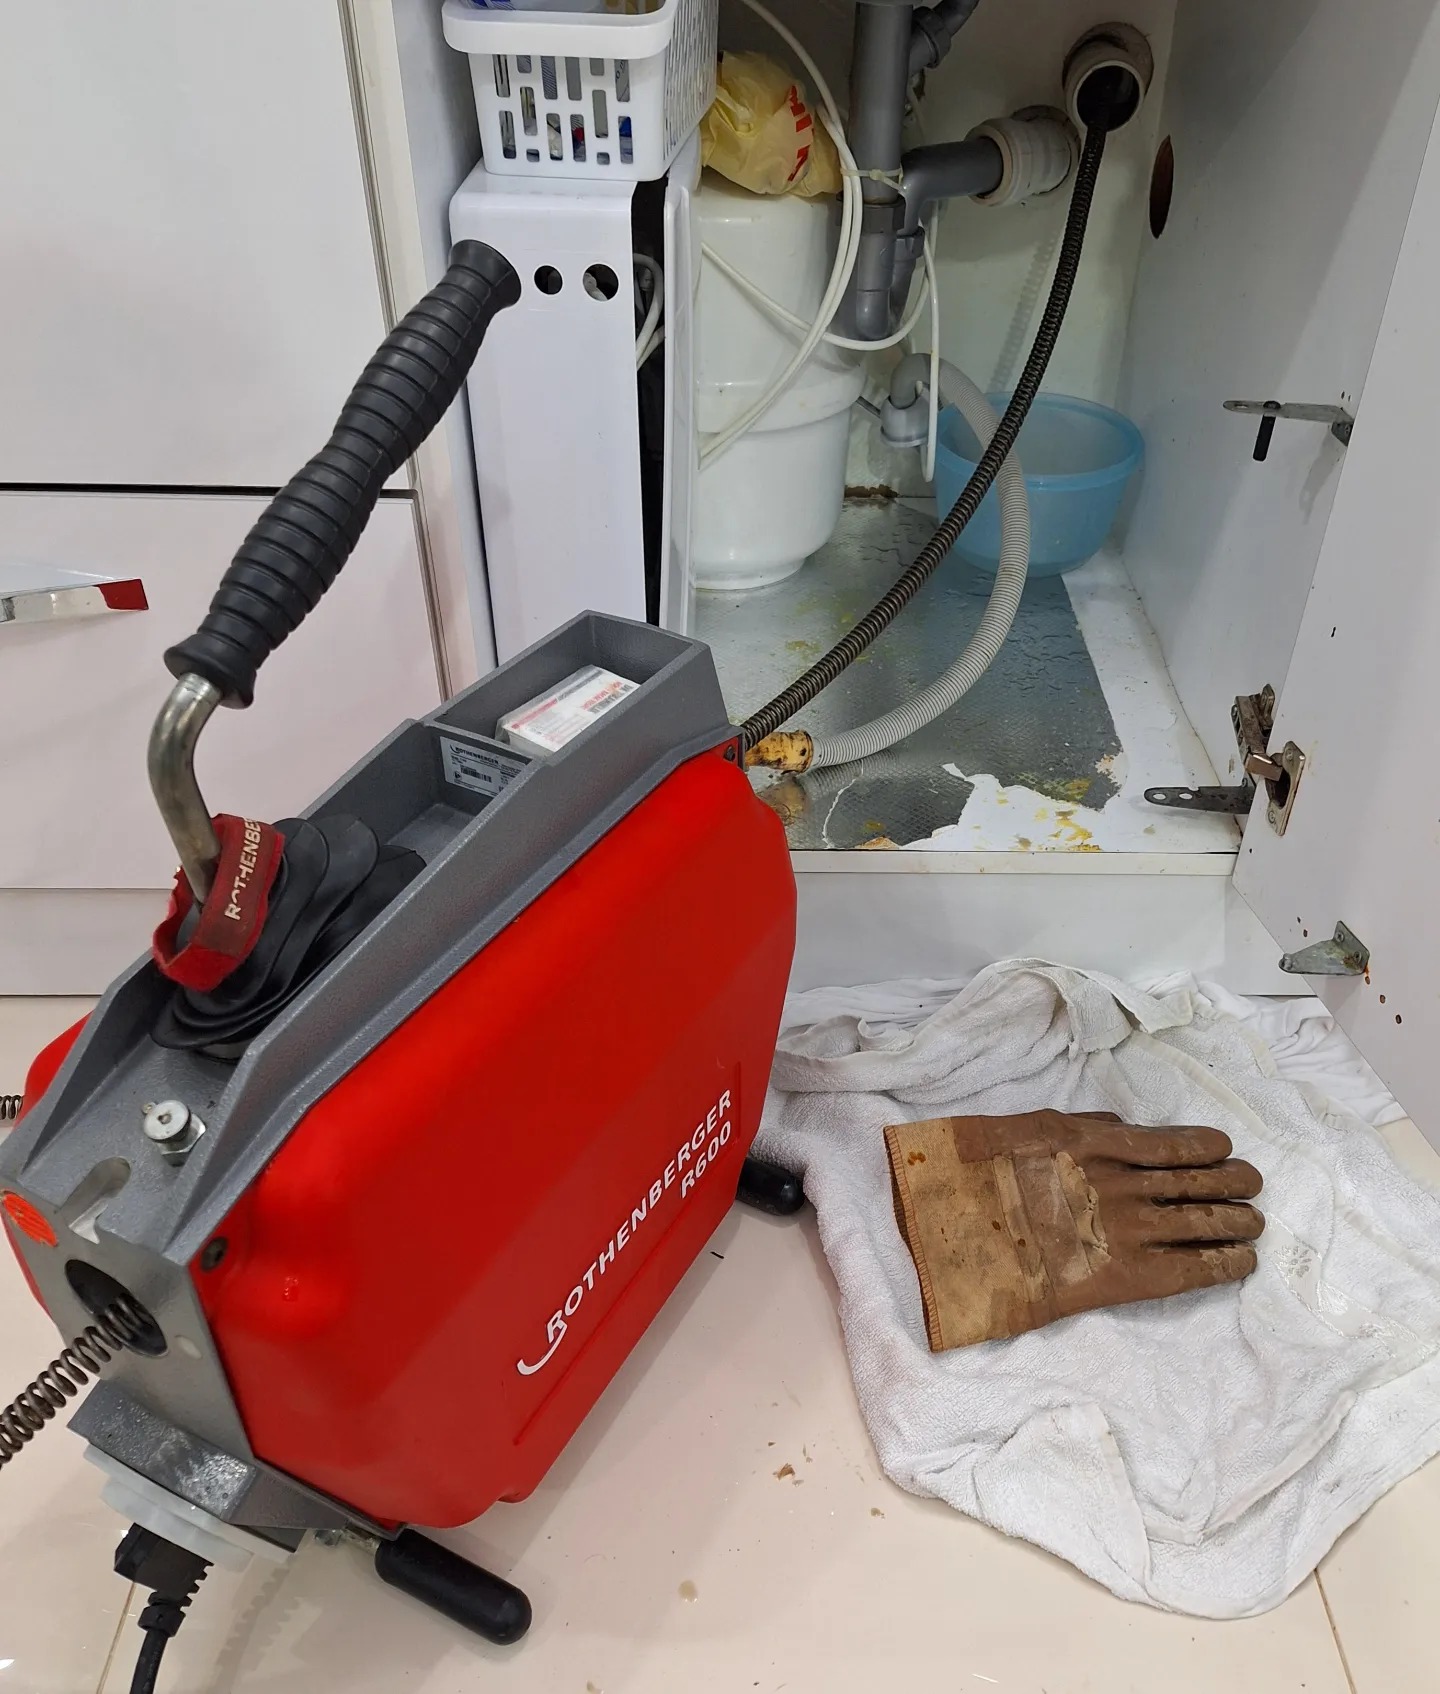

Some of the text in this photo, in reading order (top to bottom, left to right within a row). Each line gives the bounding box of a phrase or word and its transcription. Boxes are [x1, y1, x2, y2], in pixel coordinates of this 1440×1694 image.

[224, 819, 262, 920] ROTHENBE
[680, 1120, 731, 1199] R600
[516, 1089, 732, 1376] ROTHENBERGER
